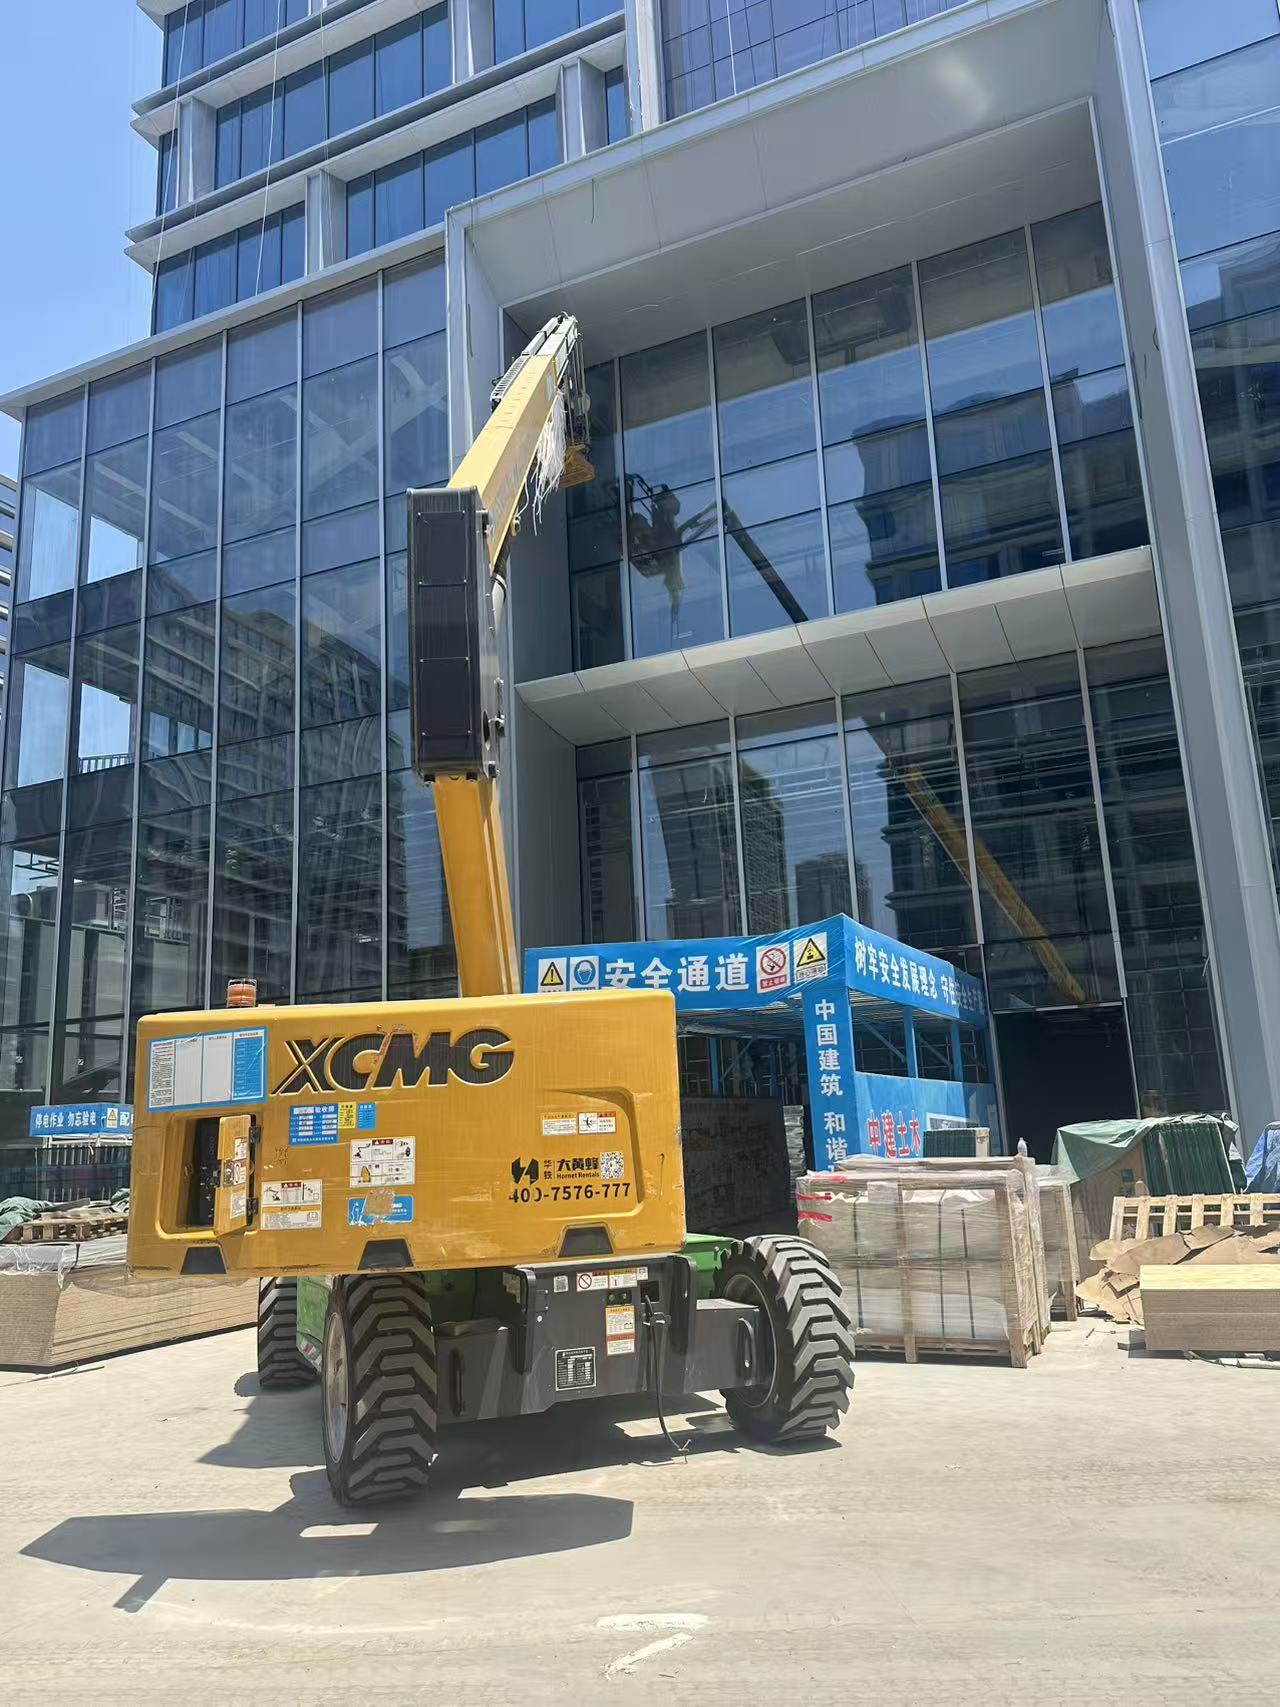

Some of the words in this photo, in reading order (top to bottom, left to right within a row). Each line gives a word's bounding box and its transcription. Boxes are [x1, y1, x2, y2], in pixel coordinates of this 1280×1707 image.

[604, 952, 750, 992] 安全通道
[270, 1028, 515, 1097] XCMG
[815, 998, 843, 1096] 中国建筑
[35, 1113, 64, 1129] 停电作业
[67, 1110, 96, 1127] 勿忘验电
[823, 1111, 848, 1172] 和谐
[867, 1110, 921, 1158] 中建土木
[557, 1157, 599, 1172] 大黄蜂
[578, 1171, 600, 1179] Rentals
